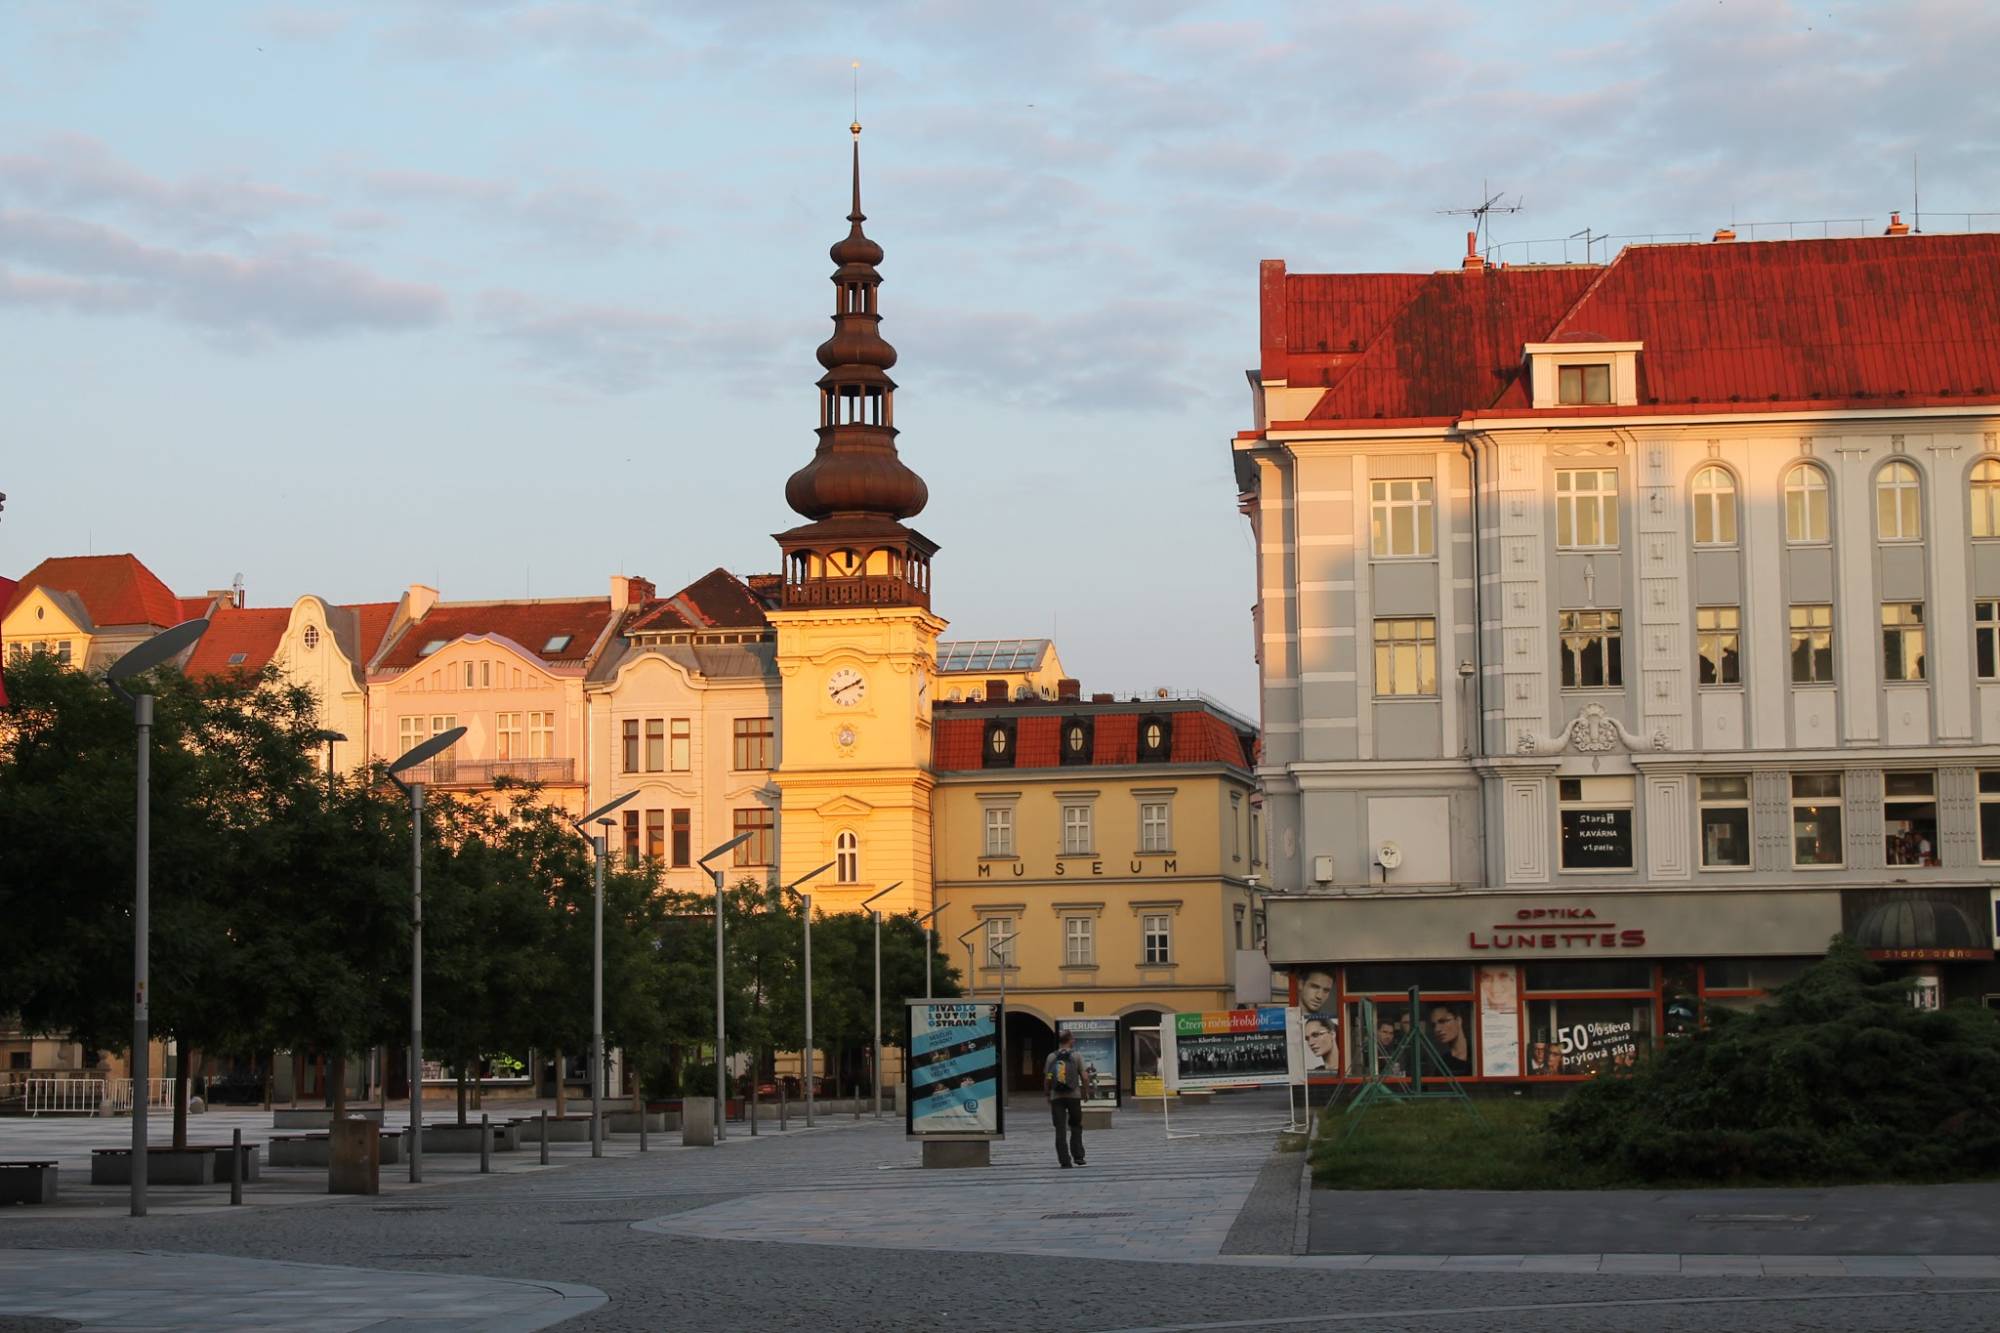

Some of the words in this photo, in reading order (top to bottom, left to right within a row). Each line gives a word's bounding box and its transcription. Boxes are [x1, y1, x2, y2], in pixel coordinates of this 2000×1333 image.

[1579, 828, 1618, 838] KAVÁRNA
[977, 859, 1177, 877] MUSEUM
[1516, 908, 1596, 920] OPTIKA
[1469, 929, 1646, 949] LUNETTES
[928, 1004, 976, 1012] DIVADLO
[928, 1019, 977, 1027] OSTRAVA
[1604, 1021, 1631, 1036] sleva
[1562, 1047, 1608, 1066] brýlová
[1611, 1043, 1636, 1056] skla
